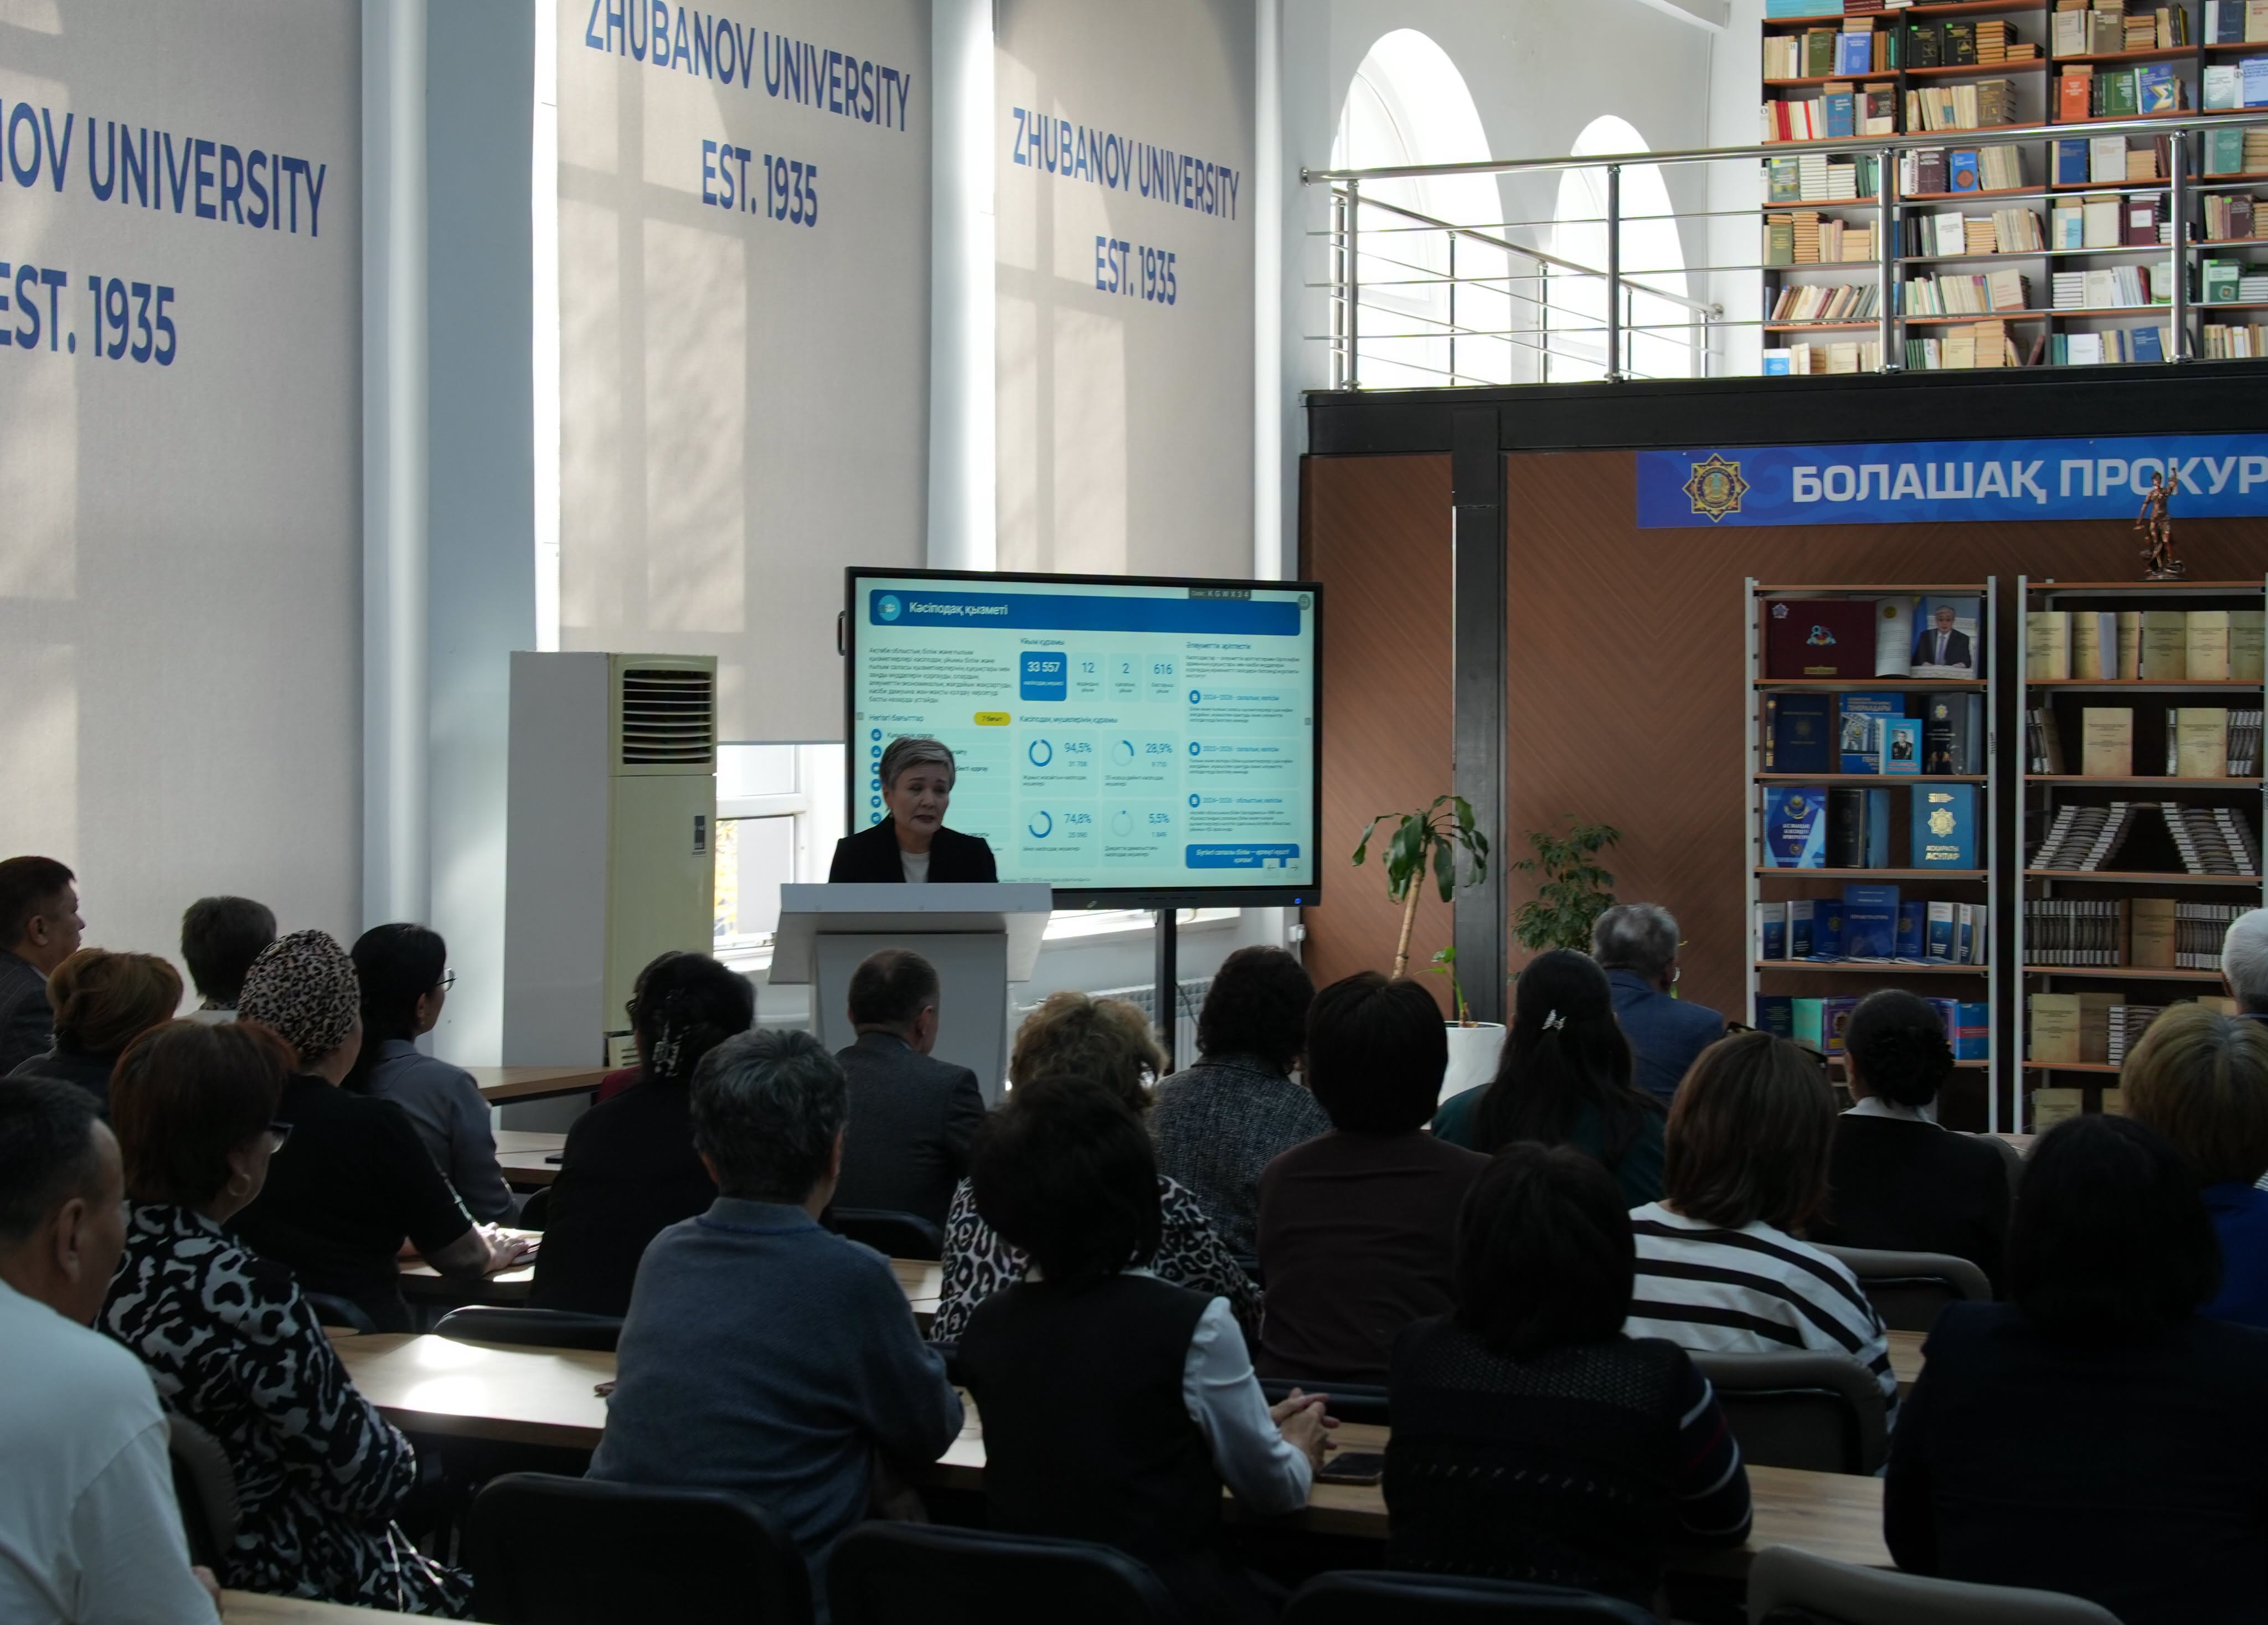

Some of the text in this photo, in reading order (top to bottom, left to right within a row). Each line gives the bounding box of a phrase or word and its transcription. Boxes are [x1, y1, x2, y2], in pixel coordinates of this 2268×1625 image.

[585, 0, 910, 131] ZHUBANOV UNIVERSITY
[0, 99, 326, 237] OV UNIVERSITY
[702, 139, 818, 227] EST. 1935
[1013, 107, 1239, 220] ZHUBANOV UNIVERSITY
[1096, 235, 1176, 305] EST. 1935
[89, 276, 176, 366] 1935
[1792, 456, 2268, 504] БОЛАШАҚ ПРОКУР
[909, 602, 1009, 616] Кәсіподақ қызметі
[1027, 661, 1061, 673] 33 557
[1081, 662, 1095, 673] 12
[1122, 663, 1130, 674] 2
[1153, 663, 1173, 674] 616
[1148, 813, 1169, 824] 5,5%
